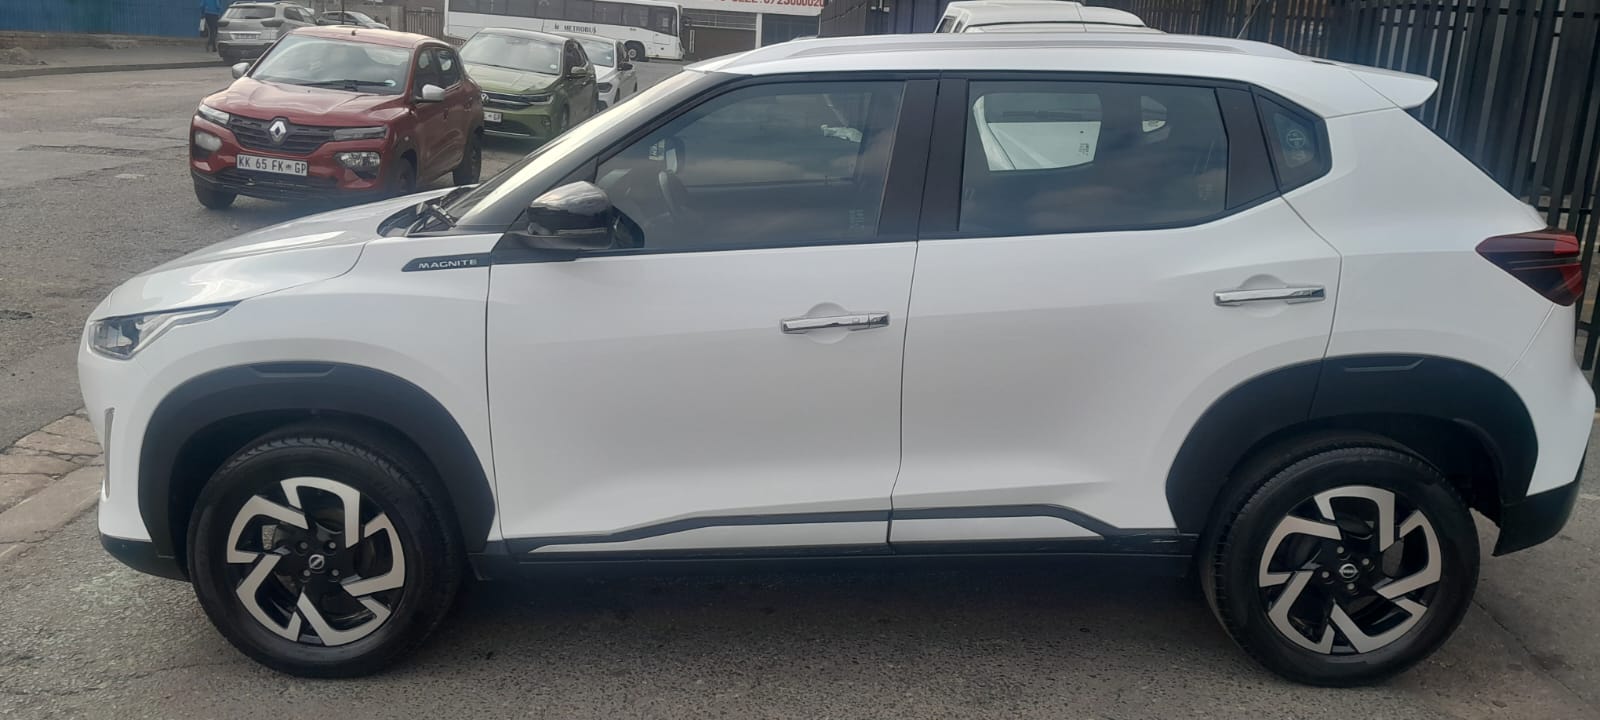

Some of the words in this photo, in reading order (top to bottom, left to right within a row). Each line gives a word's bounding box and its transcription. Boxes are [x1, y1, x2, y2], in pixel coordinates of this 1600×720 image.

[563, 24, 597, 34] METROBUS
[239, 156, 250, 167] KK
[256, 159, 267, 170] 65
[271, 160, 284, 171] FK
[295, 163, 306, 174] GP
[418, 259, 477, 269] MAGNITE
